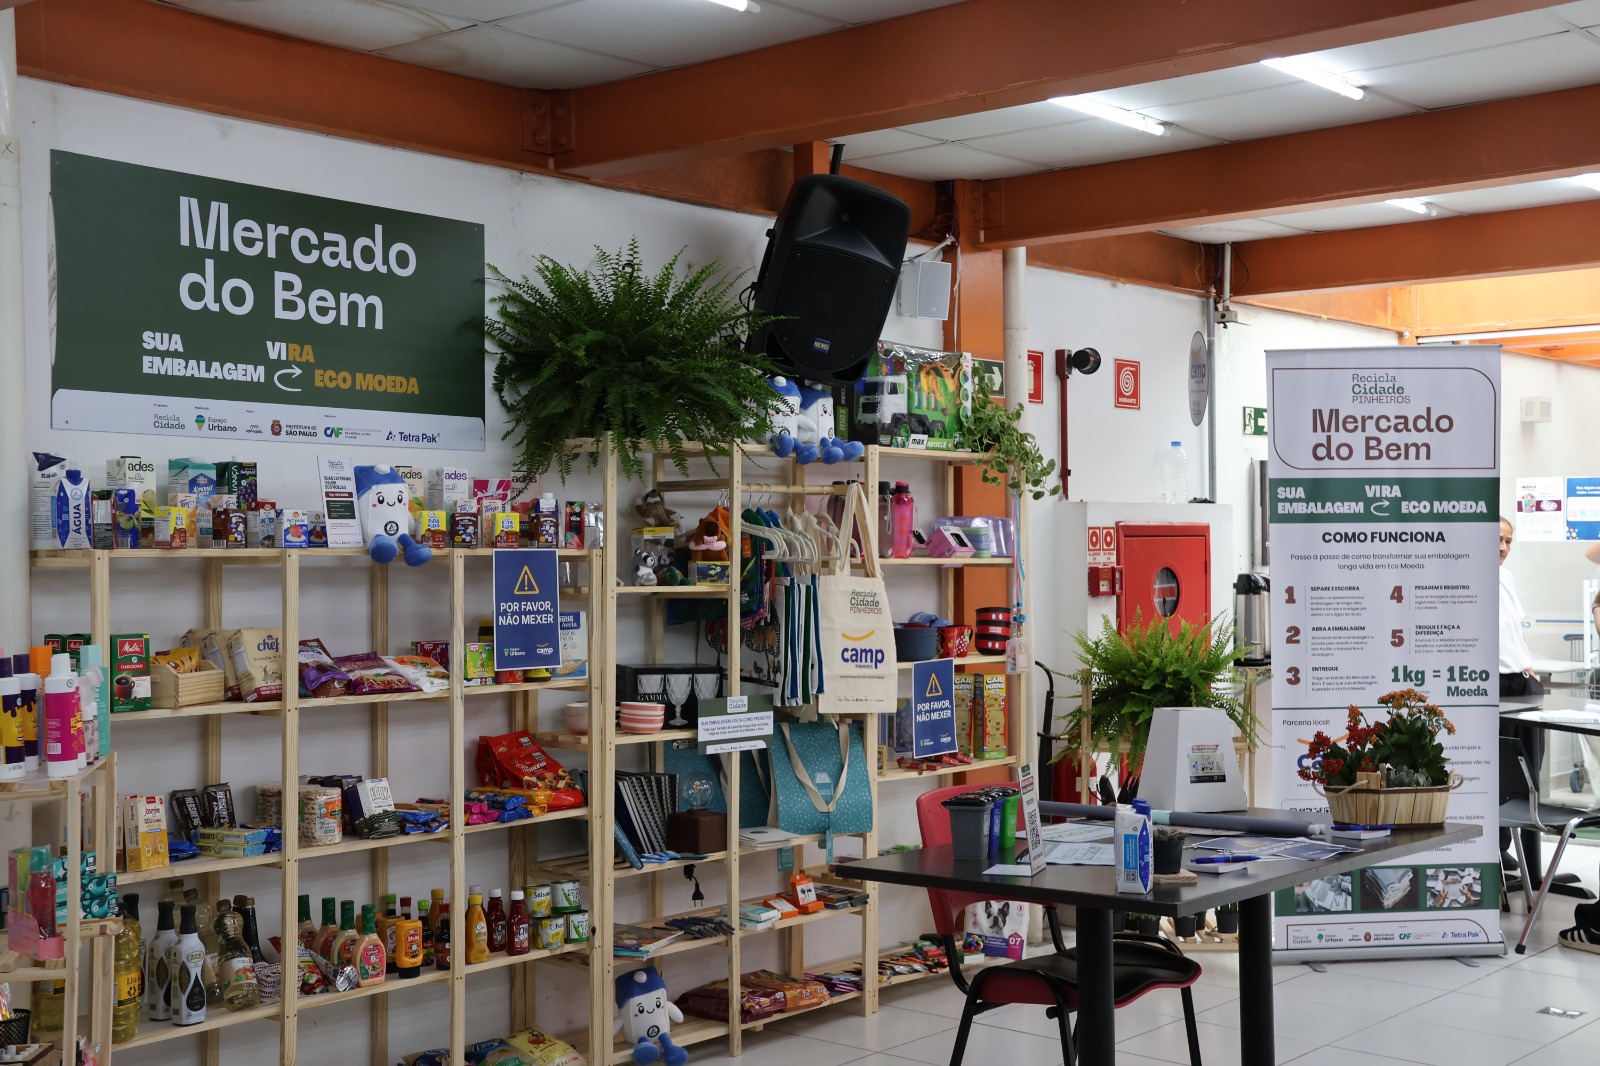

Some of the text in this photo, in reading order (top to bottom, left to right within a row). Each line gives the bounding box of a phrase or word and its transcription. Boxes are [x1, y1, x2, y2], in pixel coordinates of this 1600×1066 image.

[179, 195, 417, 277] Mercado
[178, 258, 383, 330] do Bem
[142, 330, 315, 364] SUA VIRA
[142, 355, 420, 395] EMBALAGEM ECO MOEDA
[1352, 373, 1396, 383] Recicla
[1351, 383, 1404, 395] Cidade
[1352, 395, 1411, 404] PINHEIROS
[154, 421, 186, 430] Cidade
[207, 416, 227, 424] Espaço
[1312, 407, 1454, 433] Mercado
[208, 424, 237, 432] Urbano
[323, 427, 344, 438] CAF
[398, 432, 420, 442] Tetra
[911, 438, 925, 446] max
[1312, 435, 1431, 461] do Bem
[127, 461, 154, 471] ades
[401, 471, 423, 479] ades
[445, 470, 467, 480] ades
[1277, 485, 1401, 499] SUA VIRA
[1277, 500, 1487, 514] EMBALAGEM ECO MOEDA
[72, 504, 82, 535] ÁGUA
[1322, 531, 1446, 543] COMO FUNCIONA
[1427, 553, 1470, 561] embalagem
[1338, 563, 1358, 571] longa
[851, 589, 877, 598] Recicla
[1284, 586, 1296, 604] 1
[1389, 585, 1404, 603] 4
[500, 601, 553, 612] POR FAVOR,
[850, 597, 879, 607] Cidade
[850, 606, 882, 614] PINHEIROS
[498, 614, 554, 625] NÃO MEXER
[1286, 626, 1300, 644] 2
[1390, 629, 1404, 647] 5
[257, 637, 280, 652] chef
[536, 647, 553, 655] camp
[841, 647, 885, 669] camp
[1286, 666, 1300, 685] 3
[1446, 685, 1488, 697] Moeda
[637, 693, 668, 701] GAMMA
[917, 700, 951, 712] POR FAVOR,
[916, 710, 951, 722] NÃO MEXER
[1282, 719, 1312, 727] Parceria
[1009, 937, 1021, 945] 07
